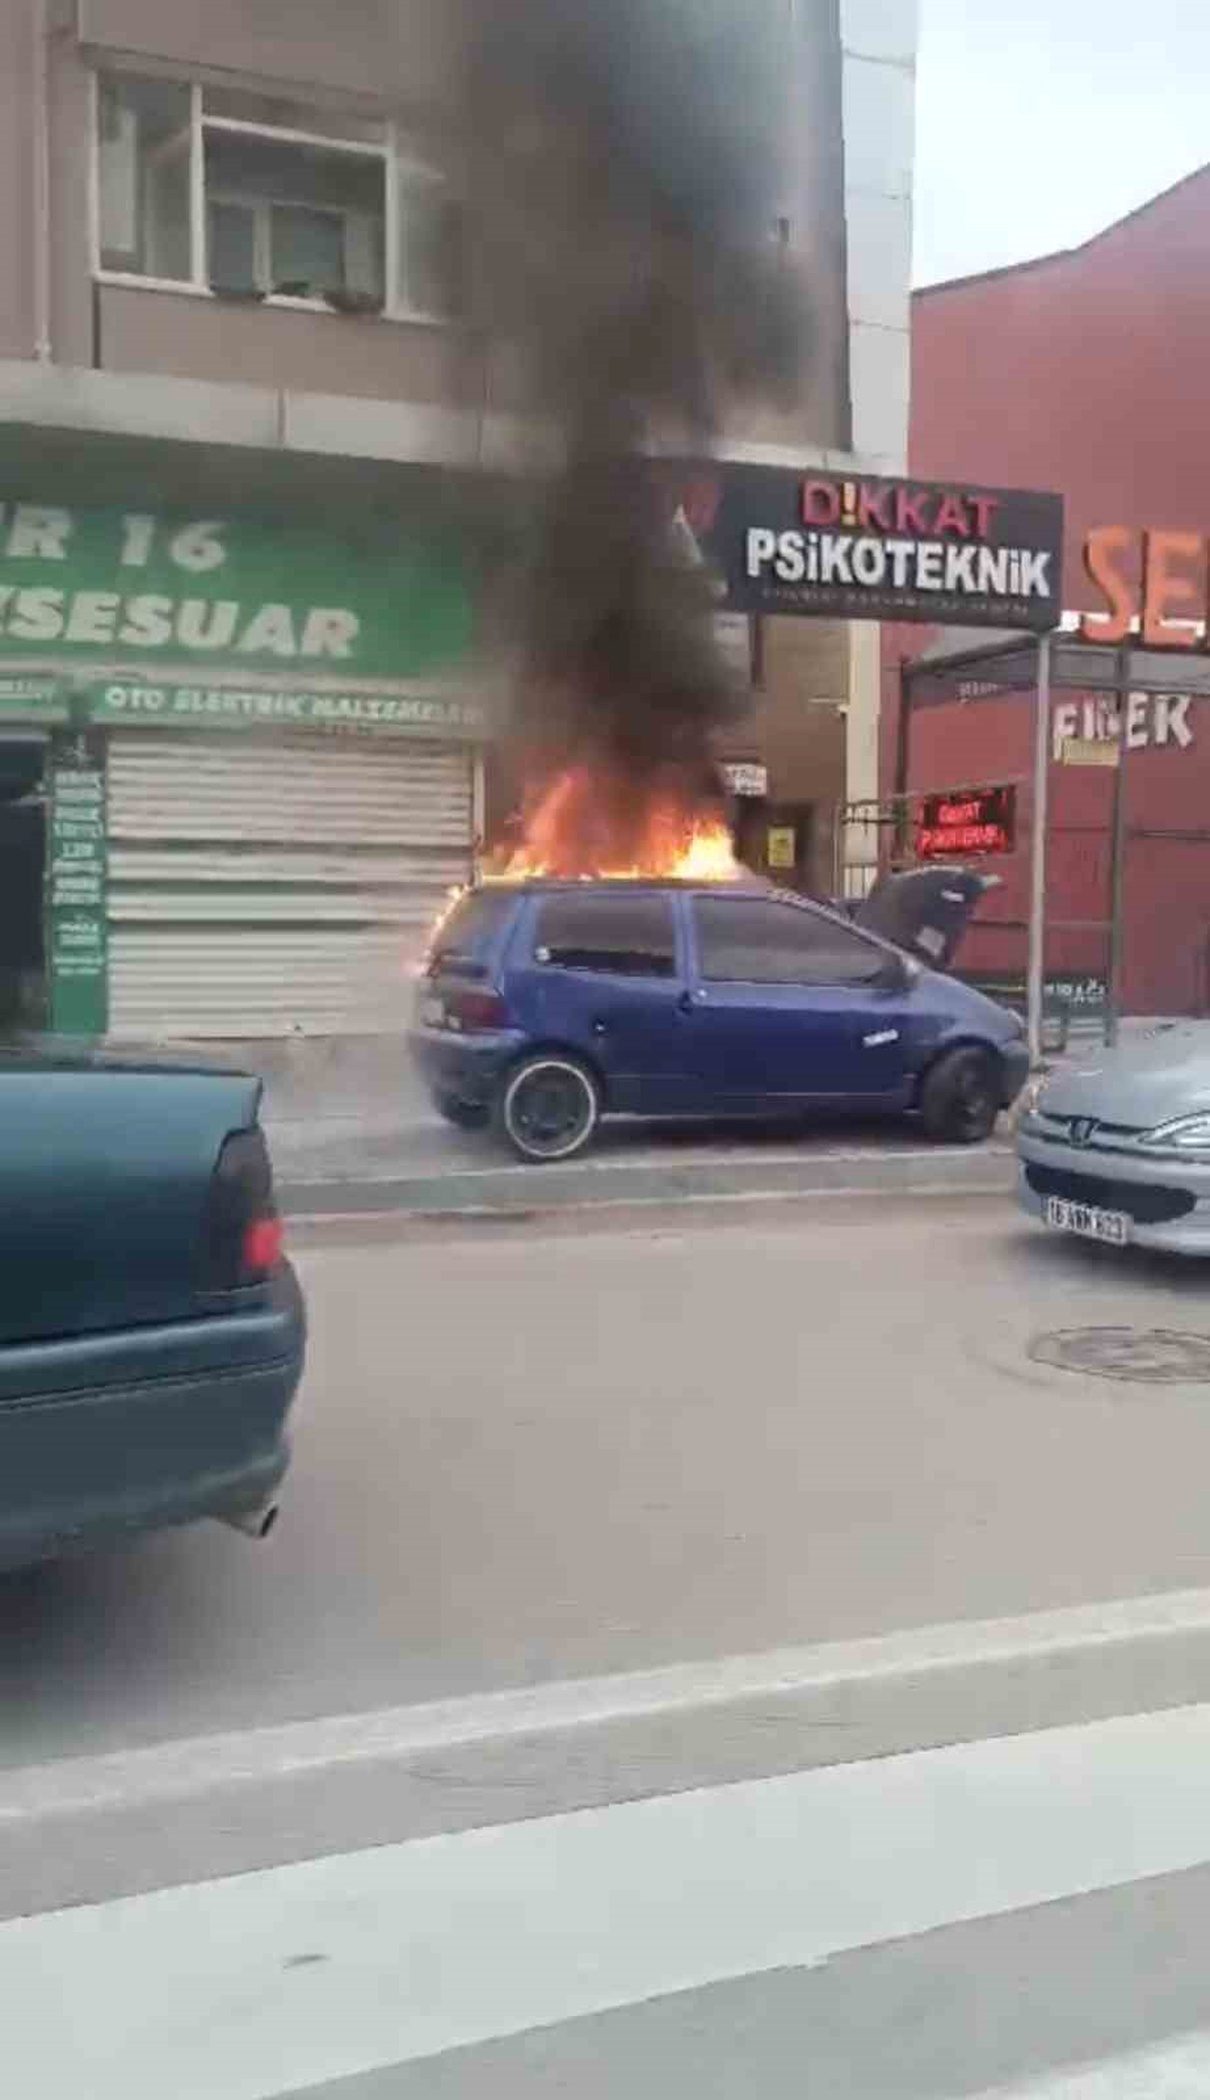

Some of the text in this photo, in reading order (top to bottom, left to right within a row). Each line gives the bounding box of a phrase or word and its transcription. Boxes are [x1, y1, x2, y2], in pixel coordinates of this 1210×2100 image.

[120, 513, 227, 572] 16
[1082, 525, 1210, 644] SE
[0, 585, 361, 658] SESUAR
[104, 686, 165, 711] OTO
